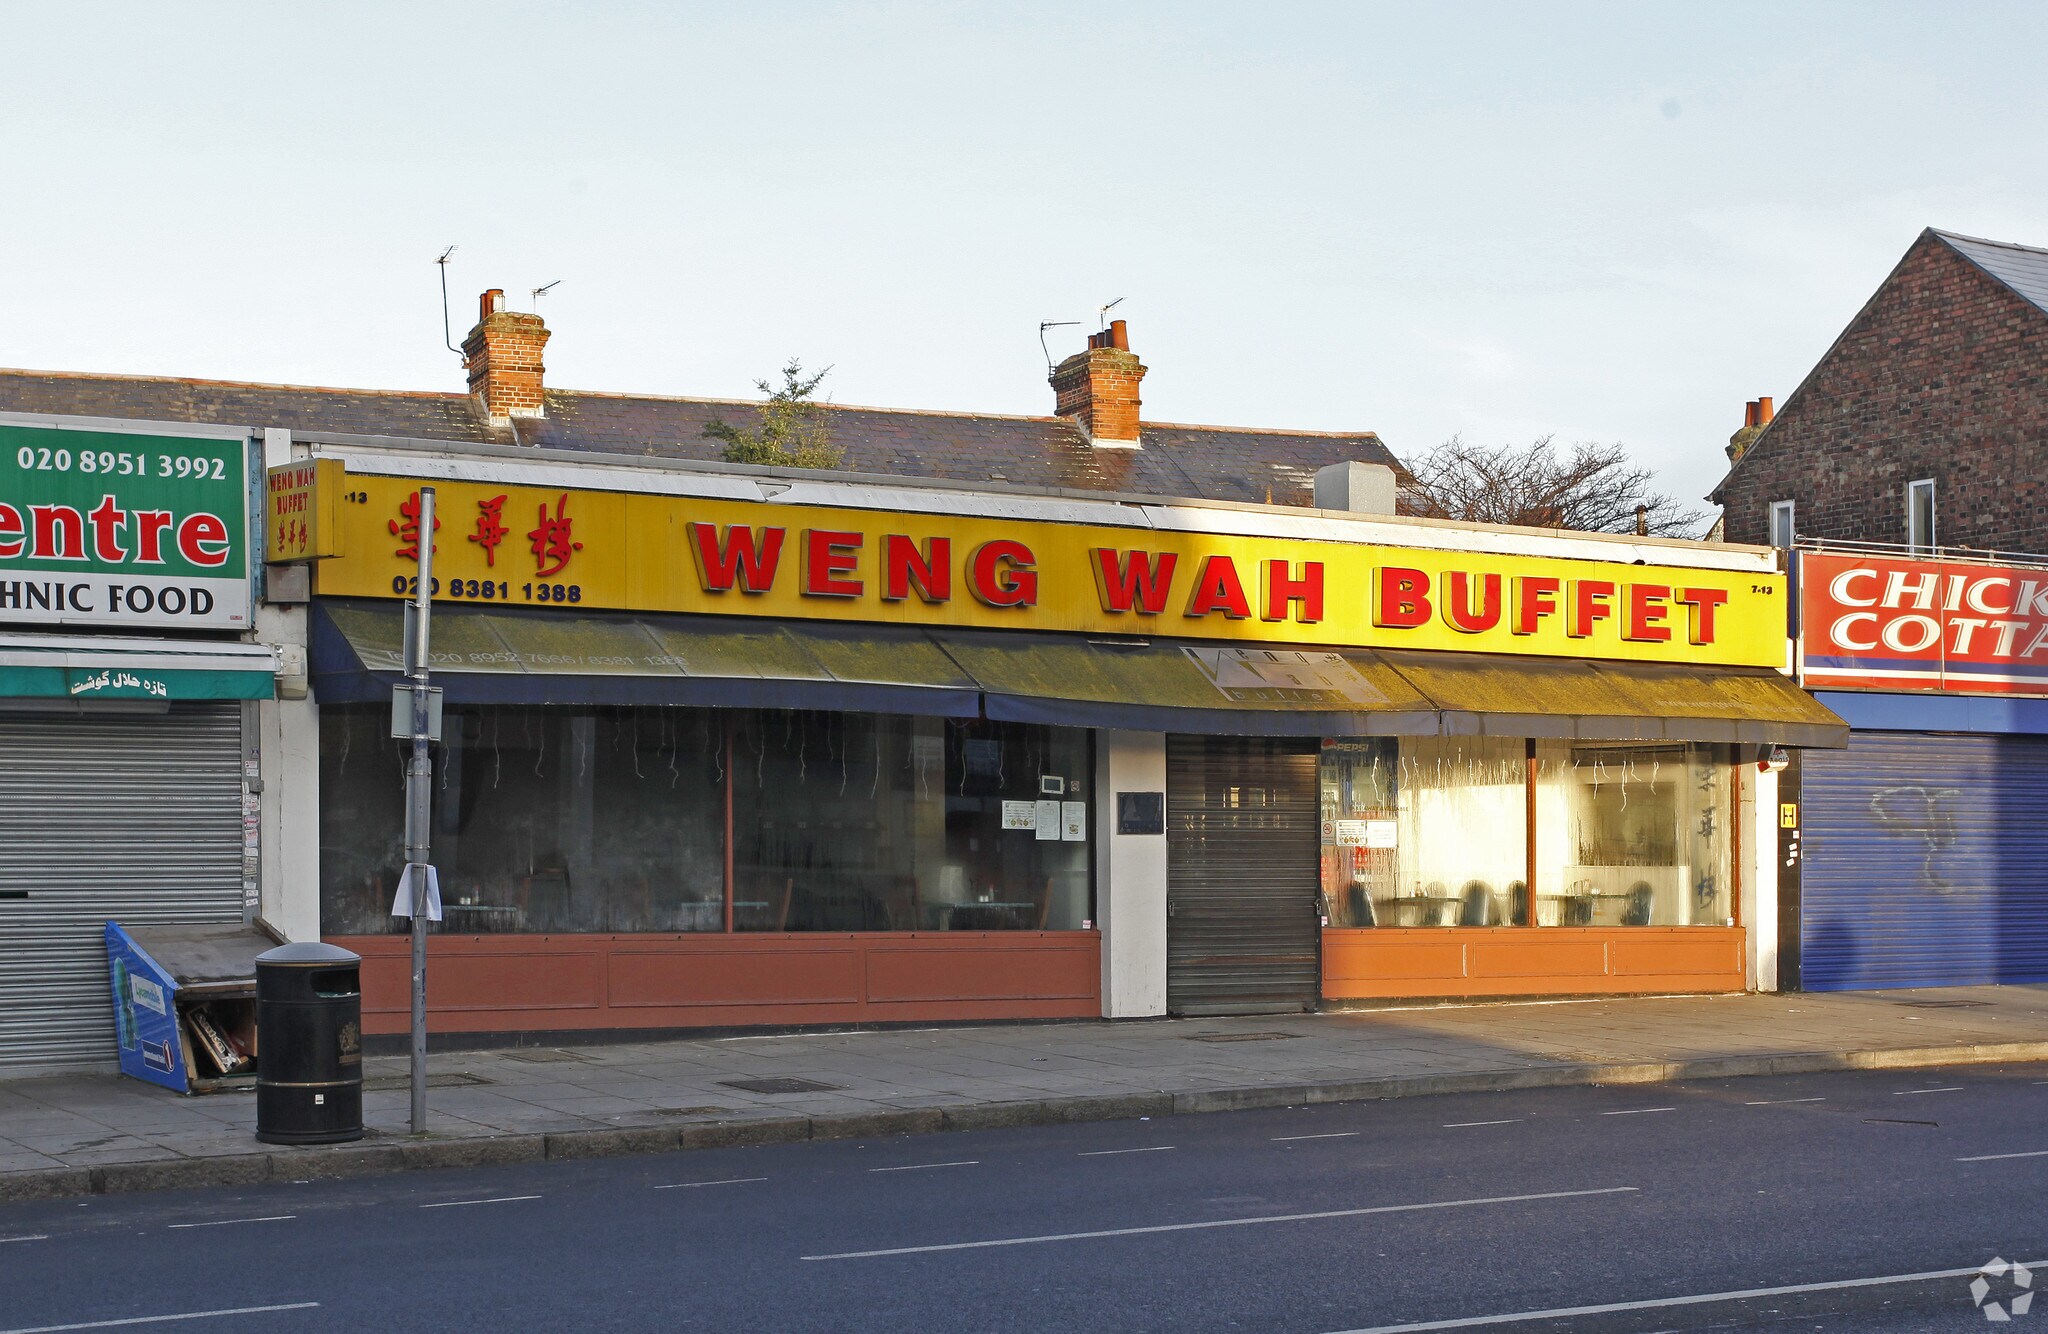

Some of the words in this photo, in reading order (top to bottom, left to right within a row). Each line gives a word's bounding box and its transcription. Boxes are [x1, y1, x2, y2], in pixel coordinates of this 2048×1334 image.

[17, 446, 73, 471] 020
[79, 450, 147, 476] 8951
[157, 454, 227, 480] 3992
[269, 470, 294, 493] WENG
[295, 466, 315, 488] WAH
[276, 491, 309, 516] BUFFET
[344, 491, 368, 505] -13
[450, 578, 509, 600] 8381
[522, 582, 582, 603] 1388
[686, 521, 1039, 608] WENG
[1089, 547, 1325, 623] WAH
[1372, 565, 1729, 646] BUFFET
[1829, 568, 2048, 617] CHICK
[108, 584, 215, 616] FOOD
[1829, 612, 2048, 658] COTTA
[469, 652, 523, 662] 8952
[112, 672, 141, 688] حلال
[1337, 743, 1369, 752] PEPSI
